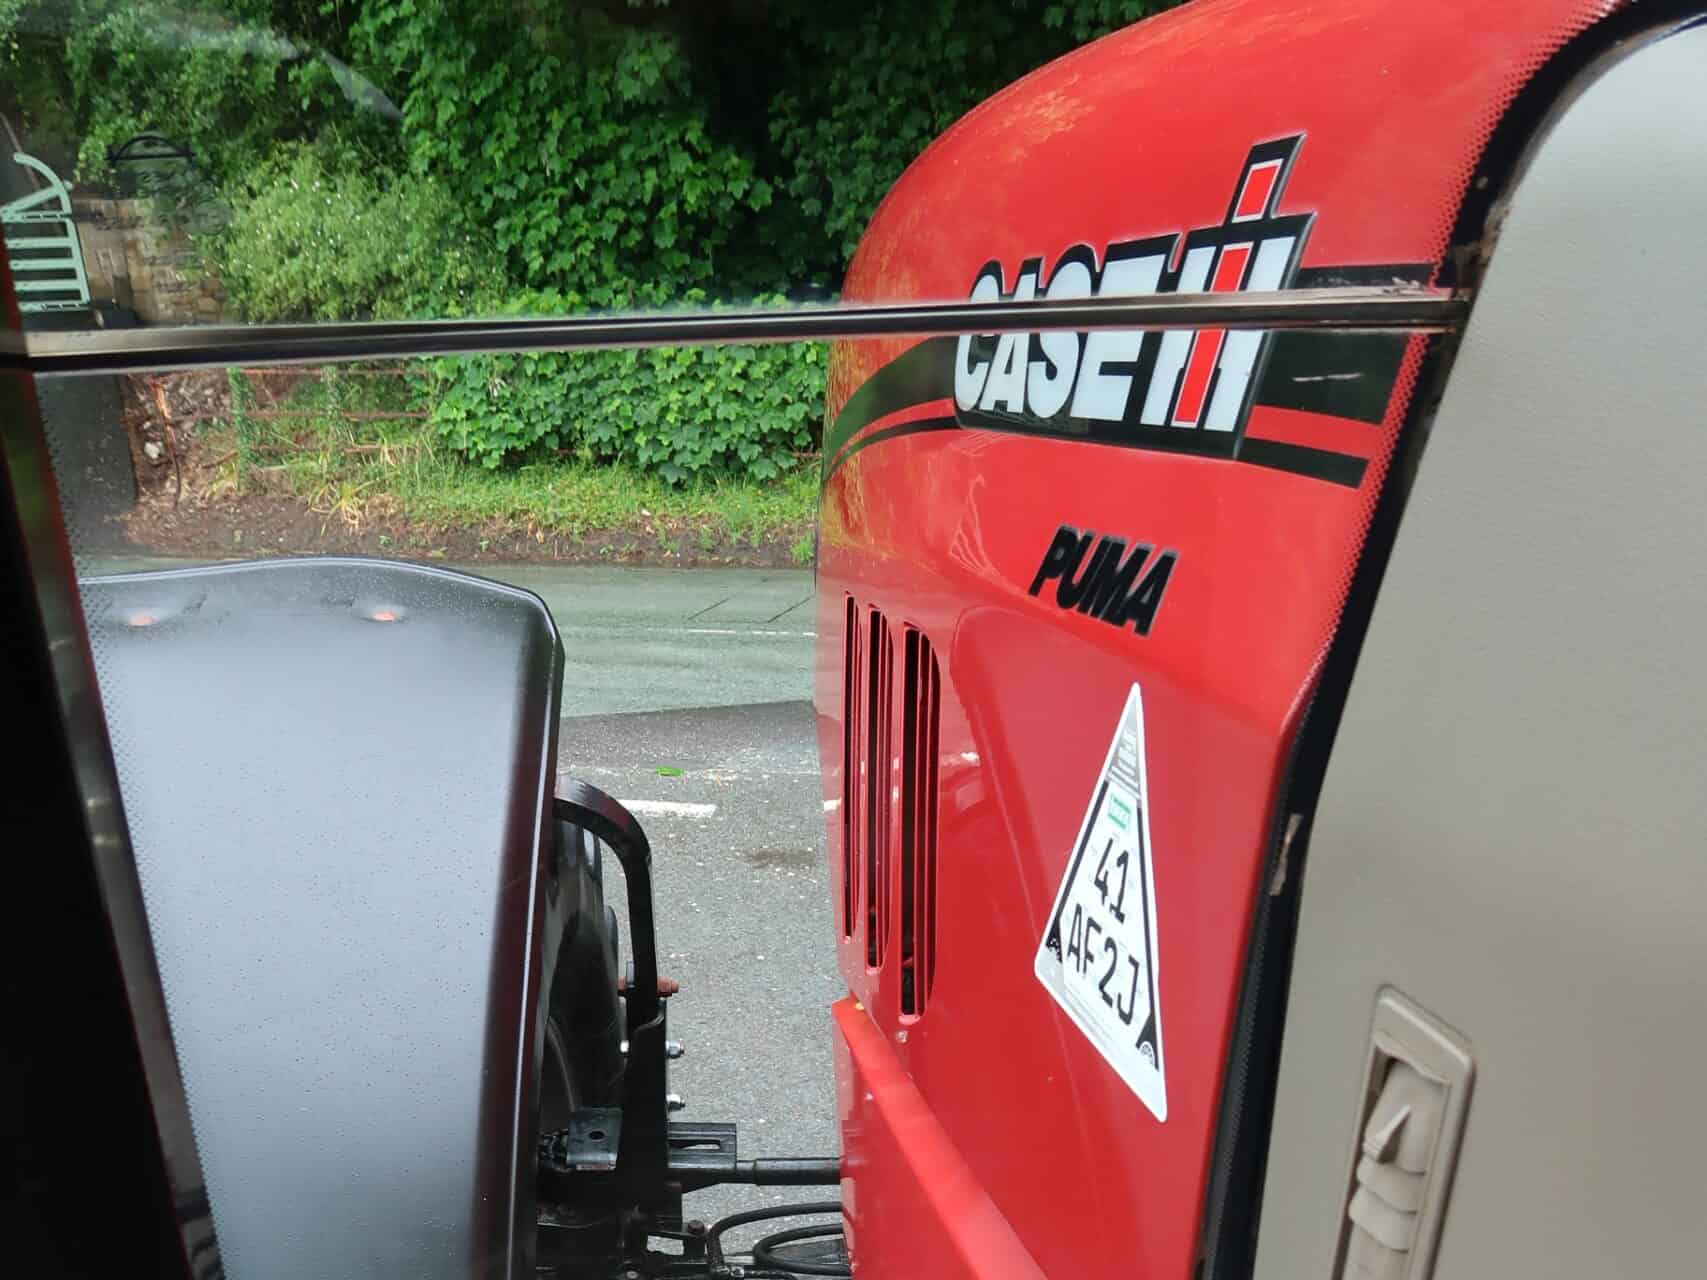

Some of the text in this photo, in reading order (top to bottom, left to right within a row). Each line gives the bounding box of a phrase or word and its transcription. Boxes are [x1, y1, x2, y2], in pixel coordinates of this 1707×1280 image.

[954, 252, 1166, 421] CASE
[1028, 525, 1177, 636] PUMA
[1094, 837, 1129, 925] 41
